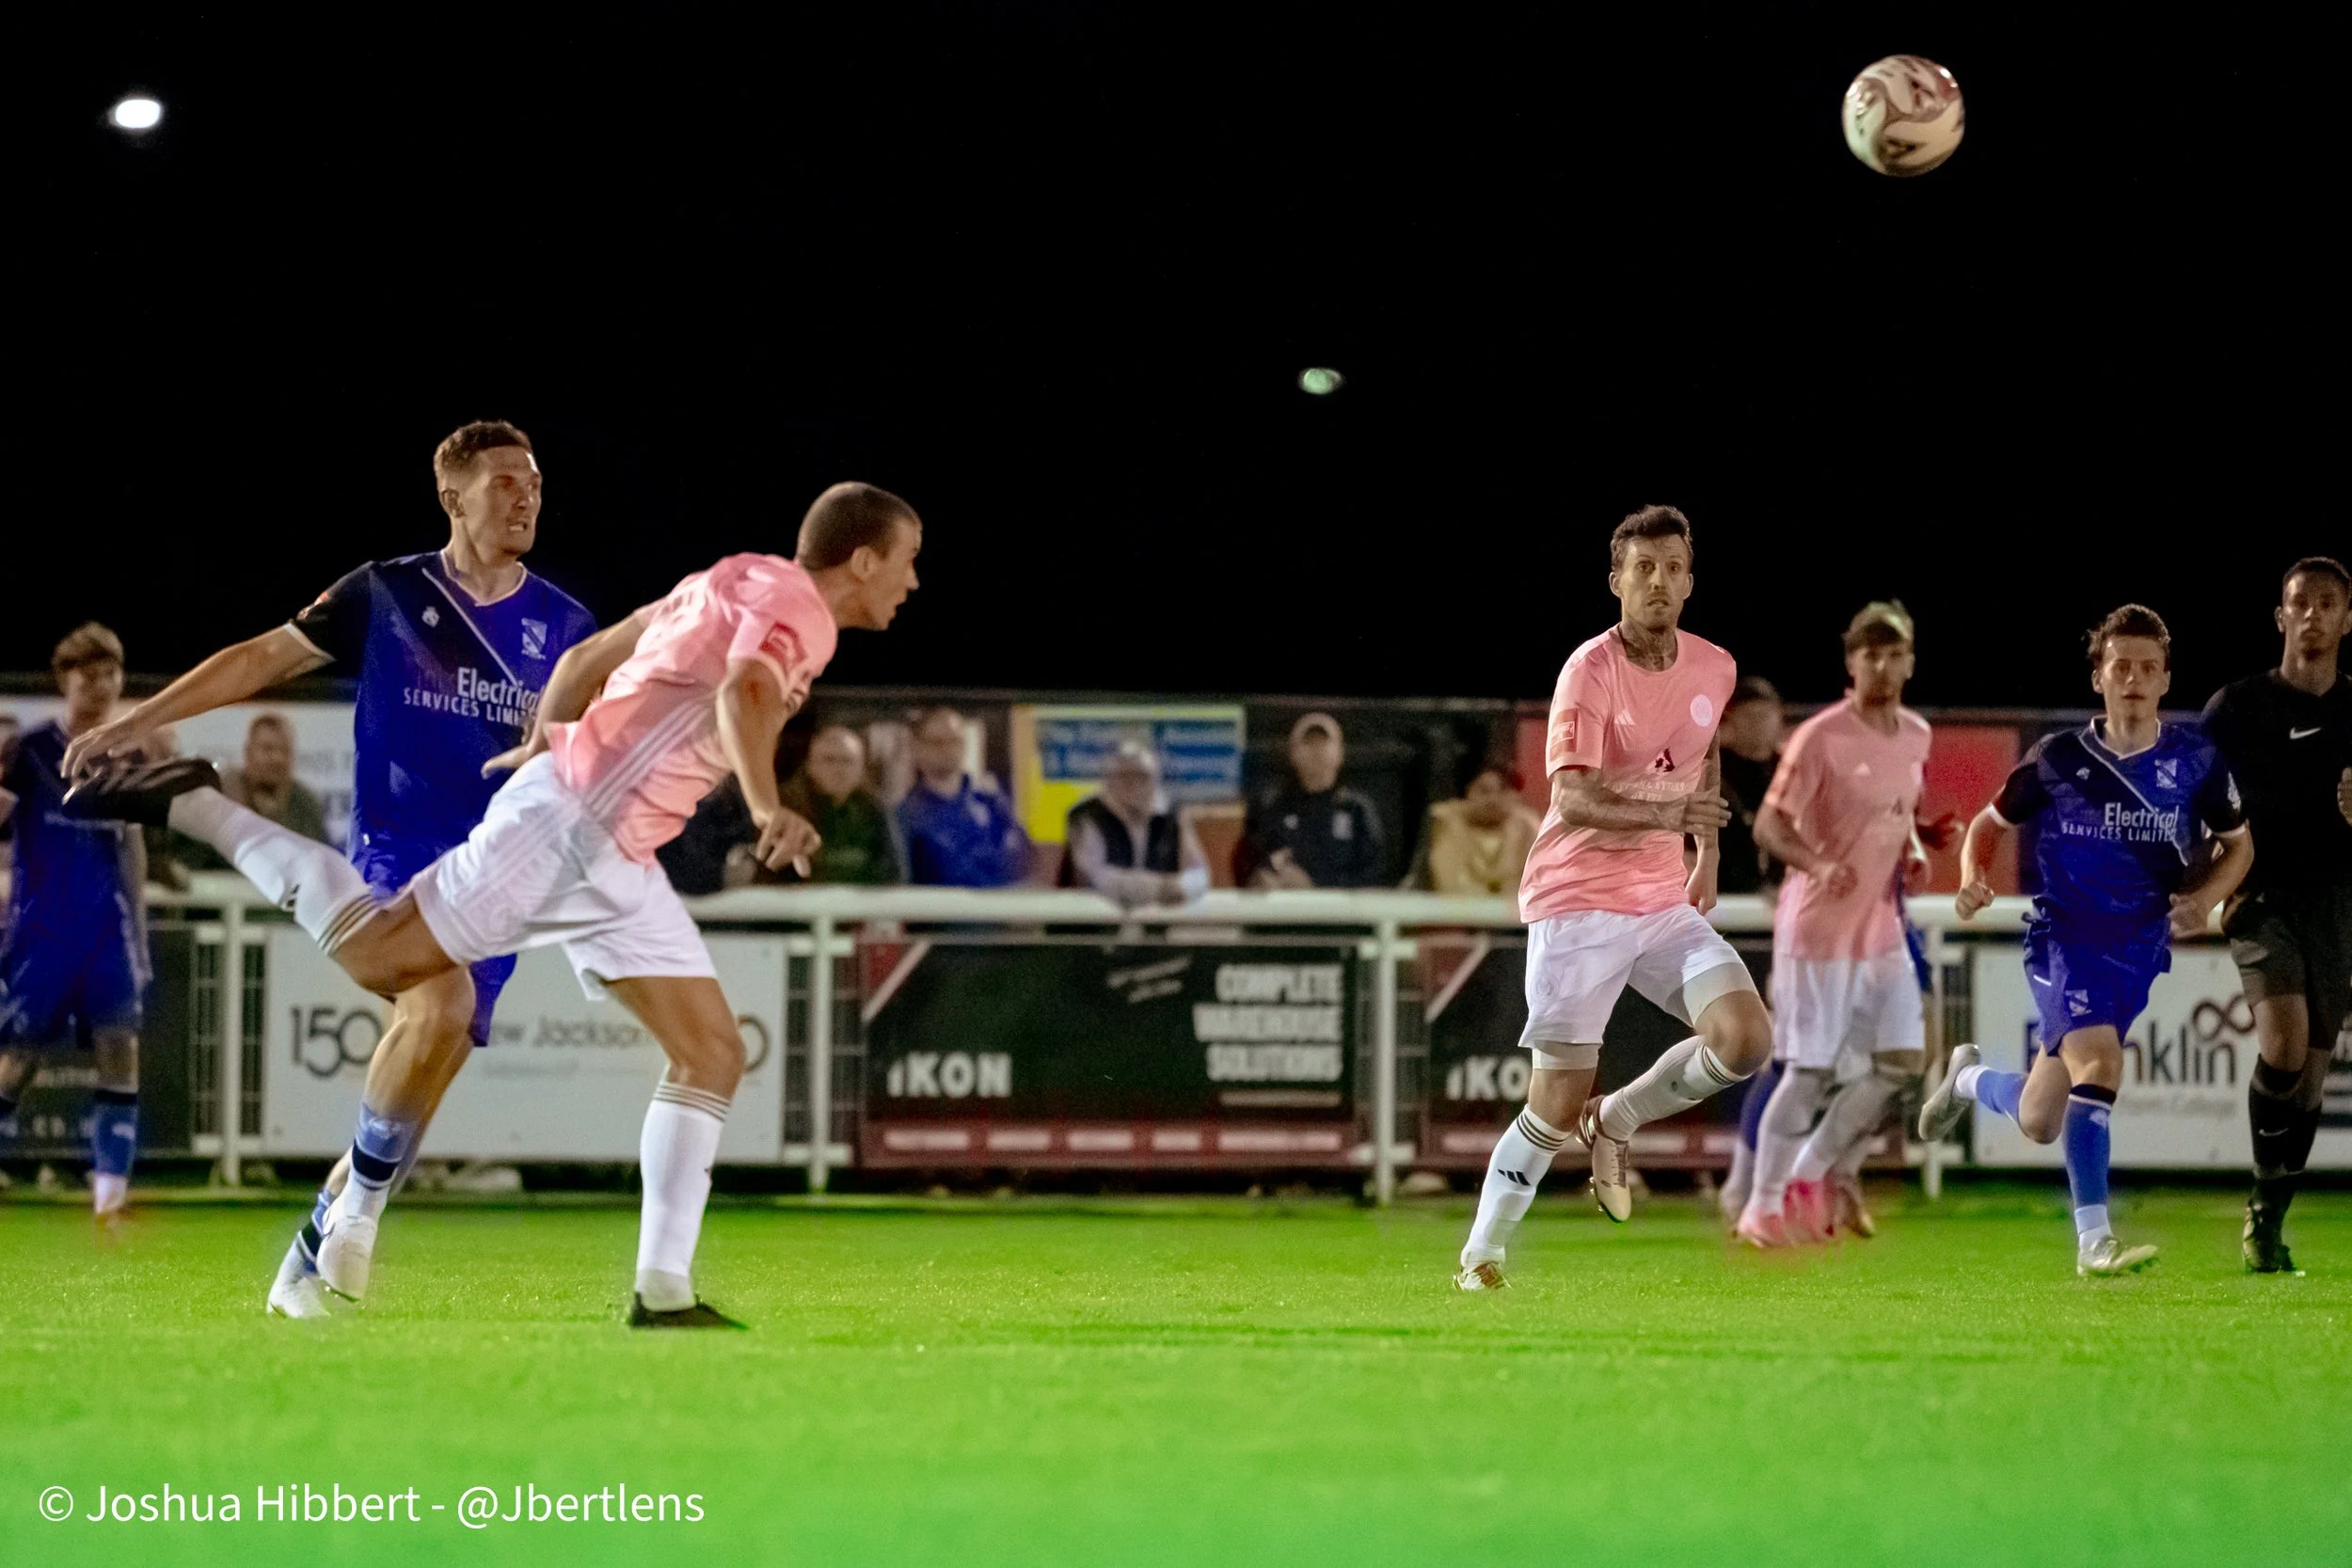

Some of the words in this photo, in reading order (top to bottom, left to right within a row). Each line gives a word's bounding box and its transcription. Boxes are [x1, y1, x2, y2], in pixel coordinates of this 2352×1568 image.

[403, 687, 480, 718] SERVICES
[485, 704, 527, 726] LIMI
[2105, 802, 2180, 829] Electrical
[290, 1005, 384, 1077] 150
[2026, 1020, 2237, 1085] Fnklin
[1446, 1055, 1532, 1101] IKO
